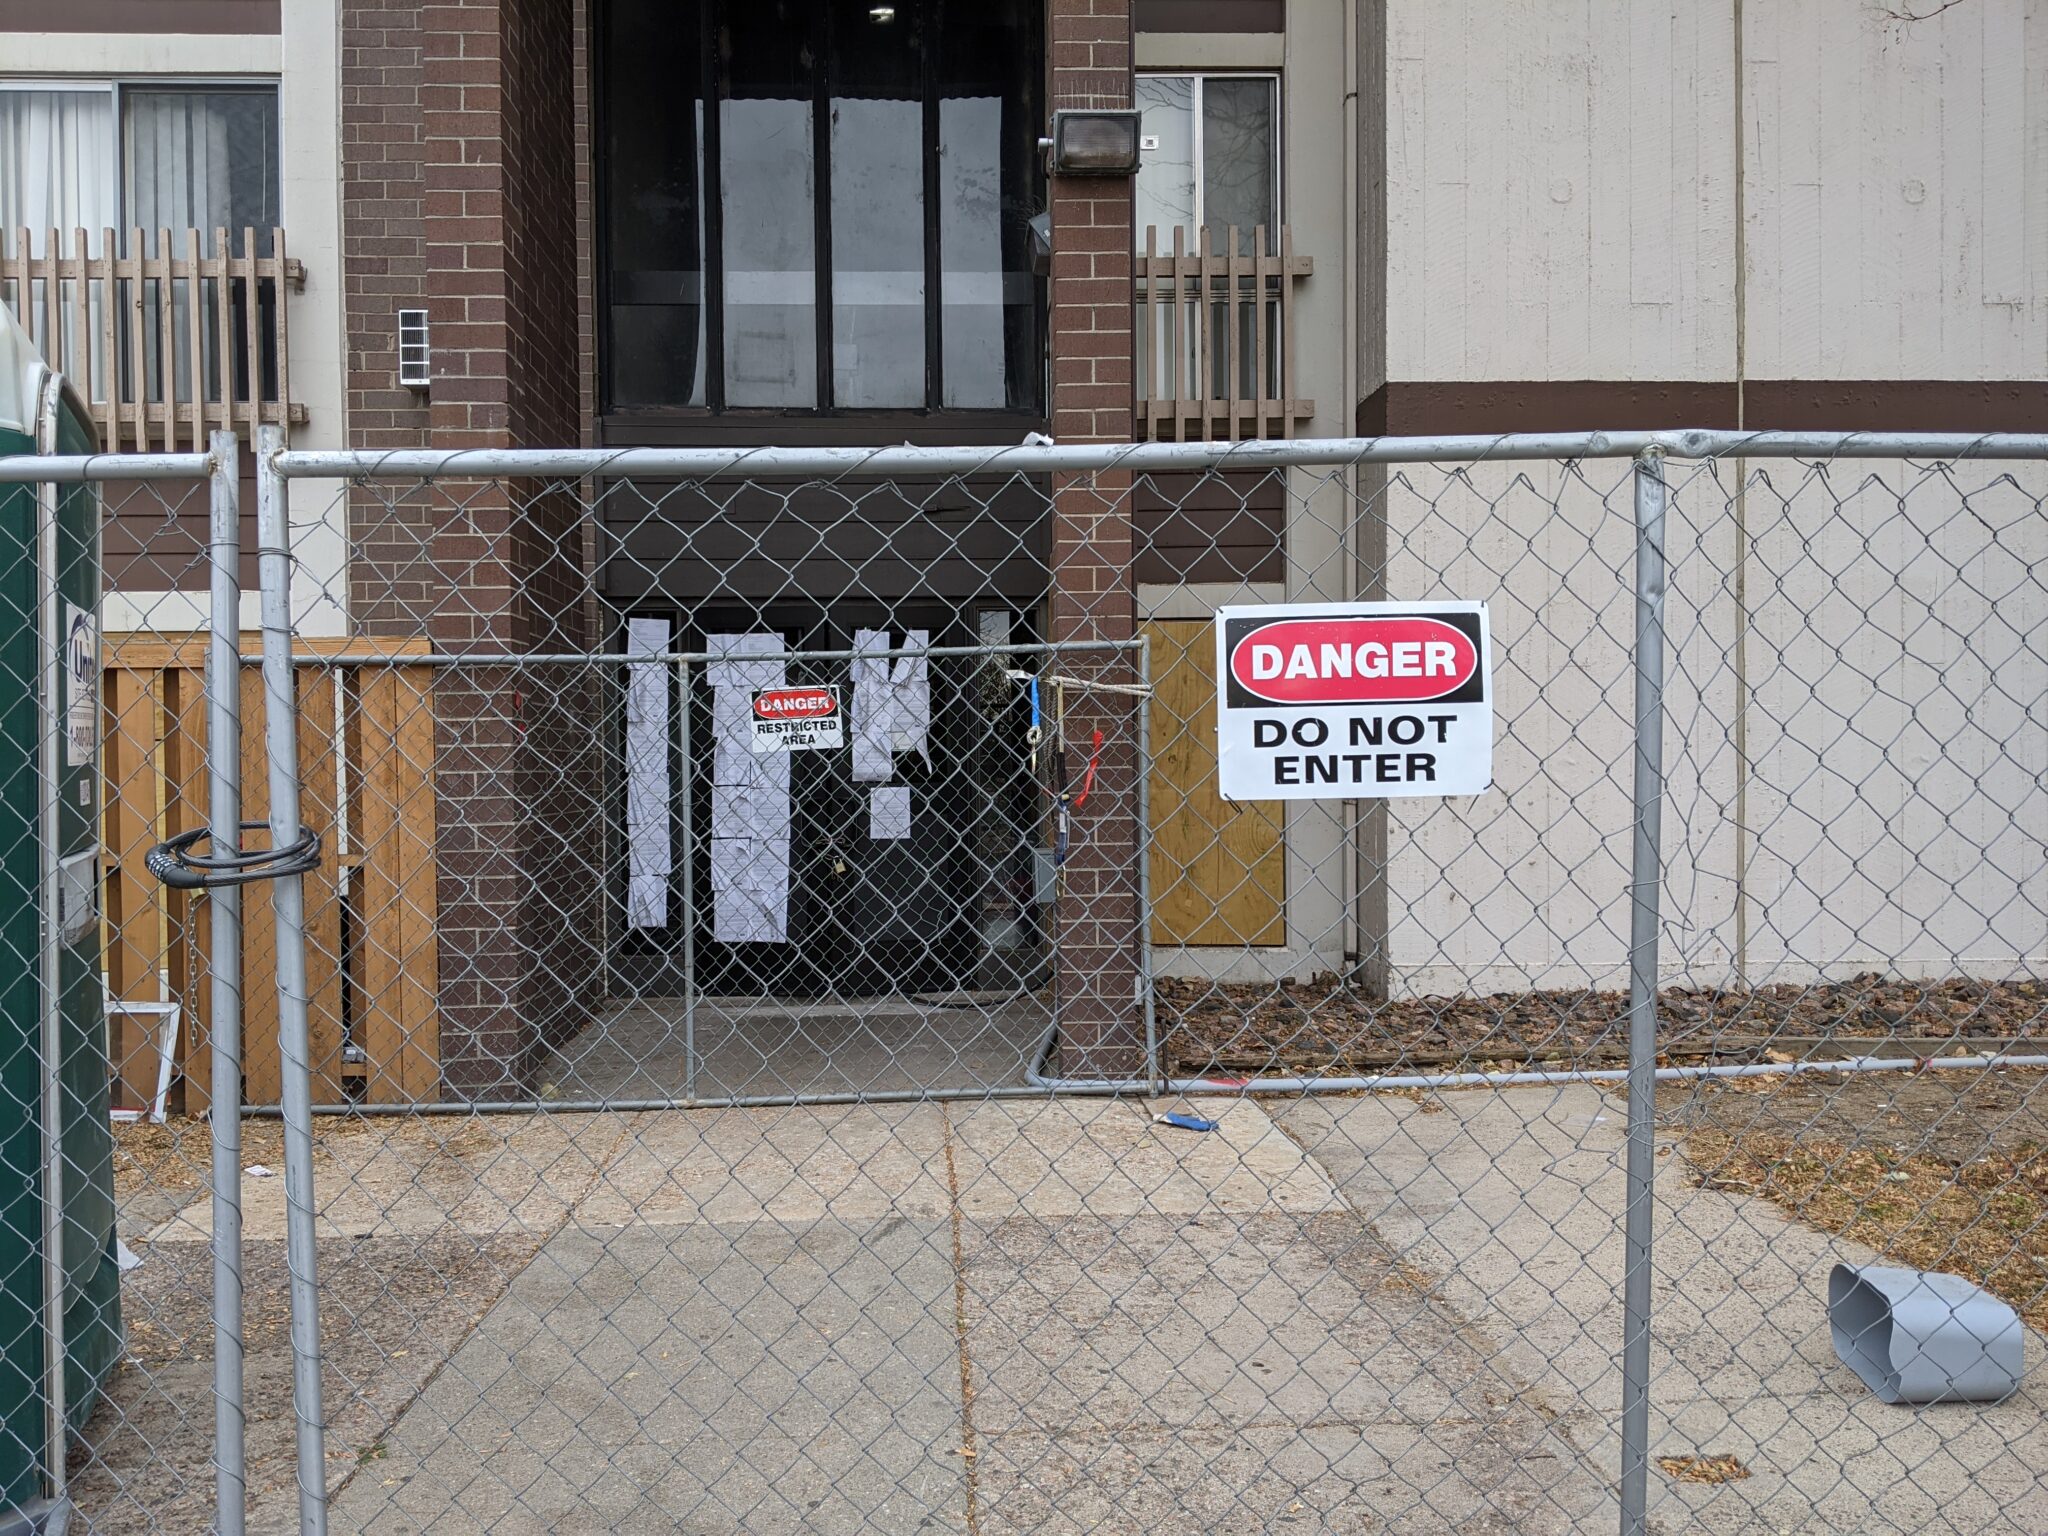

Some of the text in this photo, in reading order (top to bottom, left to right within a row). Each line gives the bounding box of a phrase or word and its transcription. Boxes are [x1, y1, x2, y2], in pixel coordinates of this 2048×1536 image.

[1252, 642, 1457, 680] DANGER
[760, 697, 829, 712] DANGER
[757, 720, 836, 734] RESTRICTED
[1254, 715, 1457, 748] DO NOT
[782, 735, 816, 745] AREA
[1274, 753, 1436, 785] ENTER
